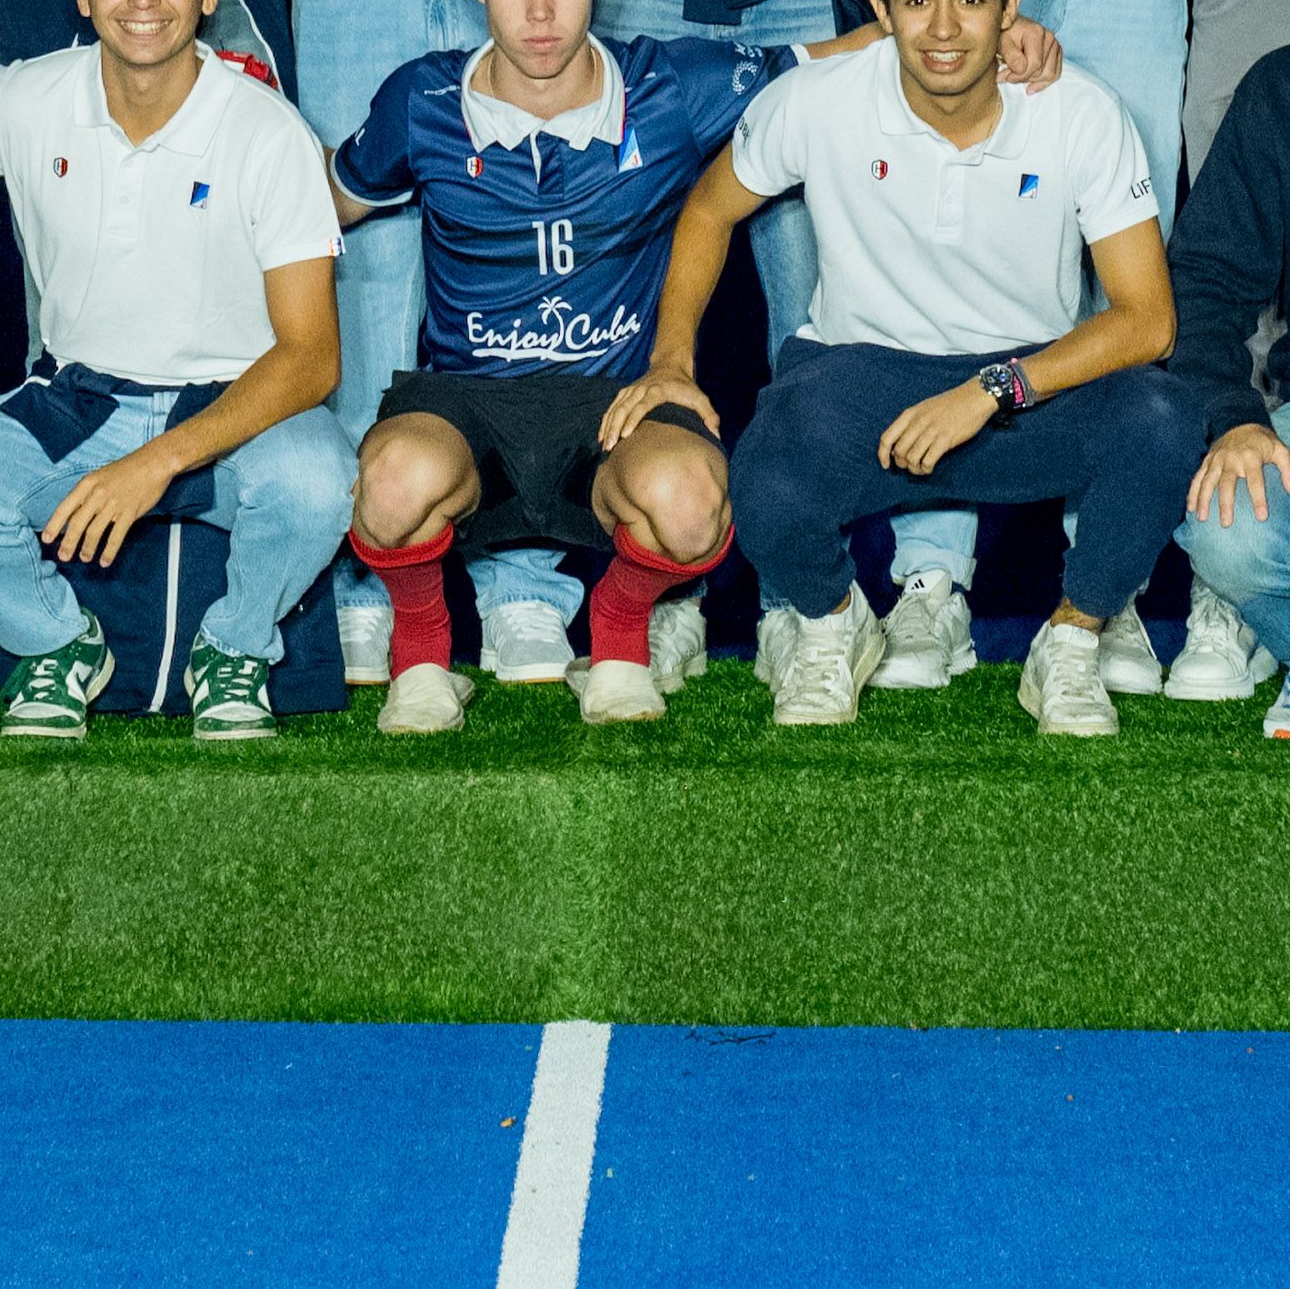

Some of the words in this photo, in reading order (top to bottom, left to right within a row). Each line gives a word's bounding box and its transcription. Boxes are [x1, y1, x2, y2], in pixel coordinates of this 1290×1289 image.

[1130, 177, 1151, 199] LIF
[531, 218, 575, 276] 16
[467, 311, 562, 361] Enjoy
[565, 305, 641, 351] Cuba
